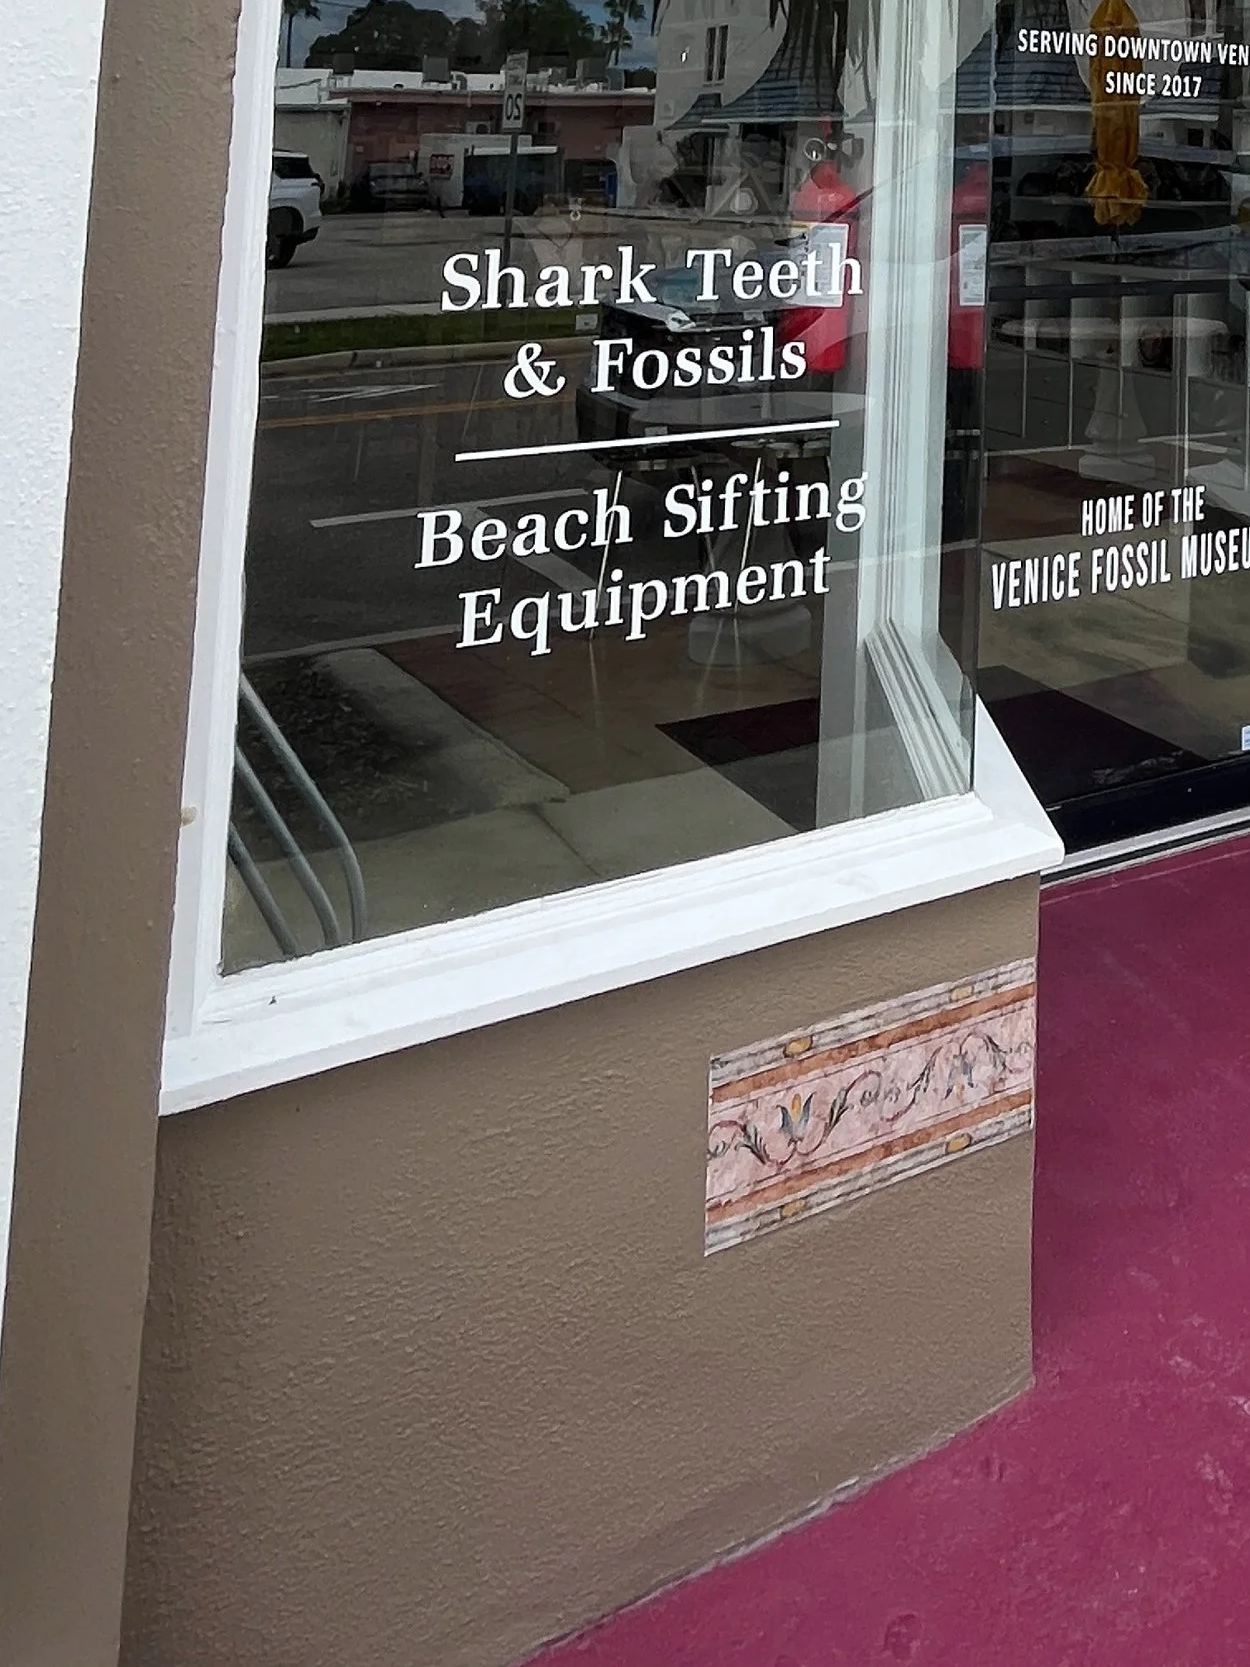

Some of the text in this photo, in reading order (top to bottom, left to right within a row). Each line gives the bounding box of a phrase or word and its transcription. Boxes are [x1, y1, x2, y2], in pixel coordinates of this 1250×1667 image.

[1017, 28, 1098, 57] SERVING
[1103, 36, 1212, 65] DOWNTOWN
[1105, 71, 1202, 98] SINCE 2017
[440, 242, 865, 312] Shark Teeth
[503, 327, 807, 399] & Fossils
[413, 470, 869, 570] Beach Sifting
[1081, 485, 1206, 537] HOME OF THE
[454, 545, 832, 657] Equipment
[991, 551, 1080, 611] VENICE
[1091, 539, 1171, 594] FOSSIL
